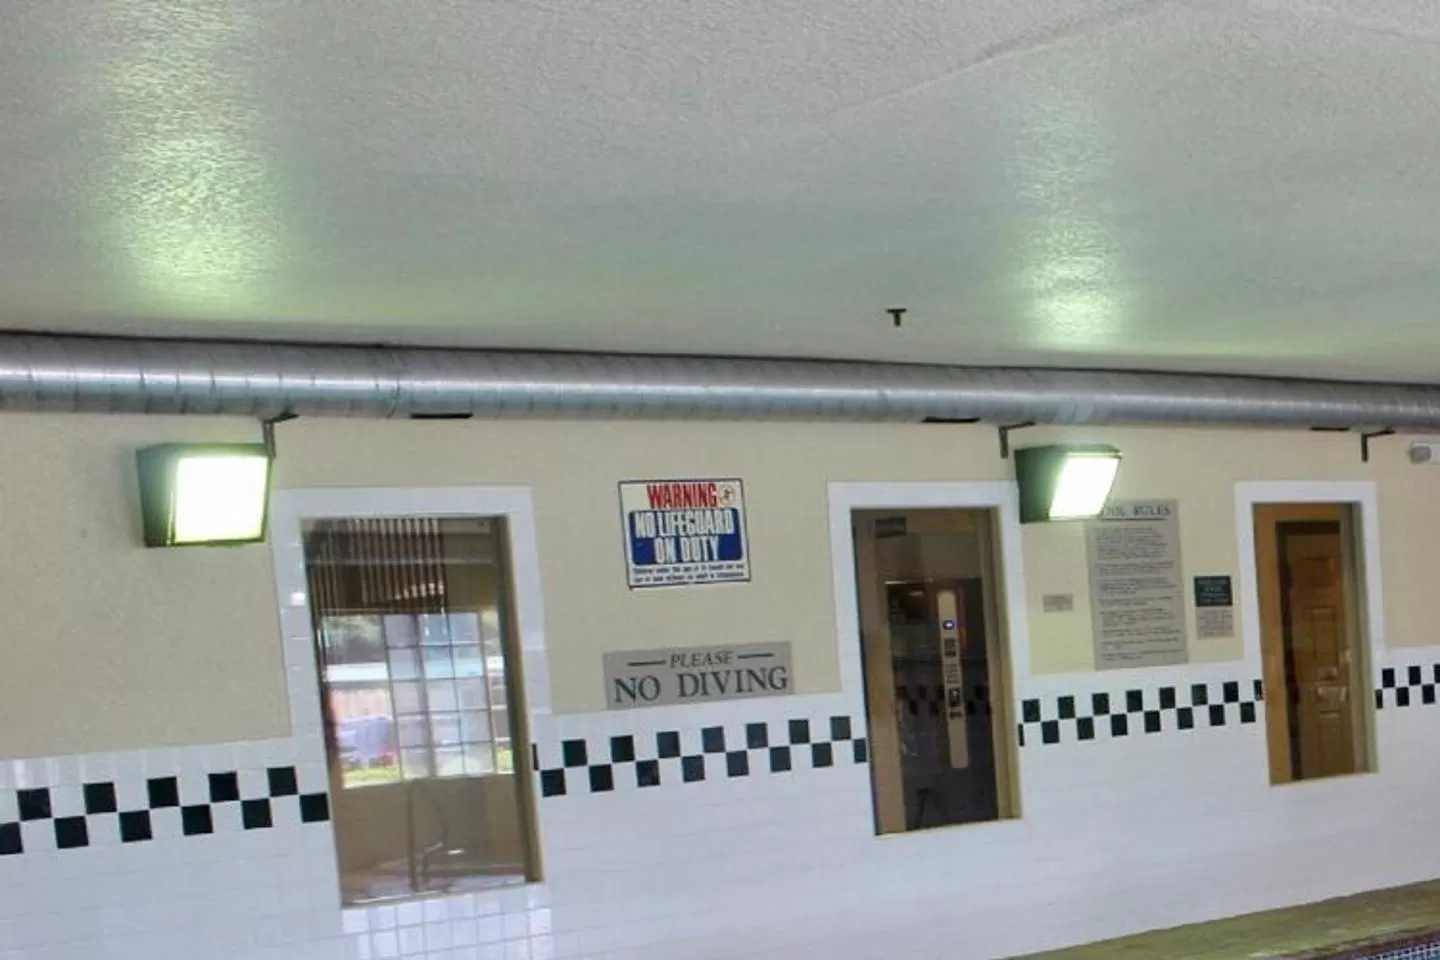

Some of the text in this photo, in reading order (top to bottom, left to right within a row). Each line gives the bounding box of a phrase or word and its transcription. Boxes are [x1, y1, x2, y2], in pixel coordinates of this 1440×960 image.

[646, 482, 718, 510] WARNING
[634, 507, 735, 539] NO LIFEGUARD
[654, 535, 719, 565] ON DUTY
[669, 651, 734, 670] PLEASE
[613, 665, 789, 704] NO DIVING
